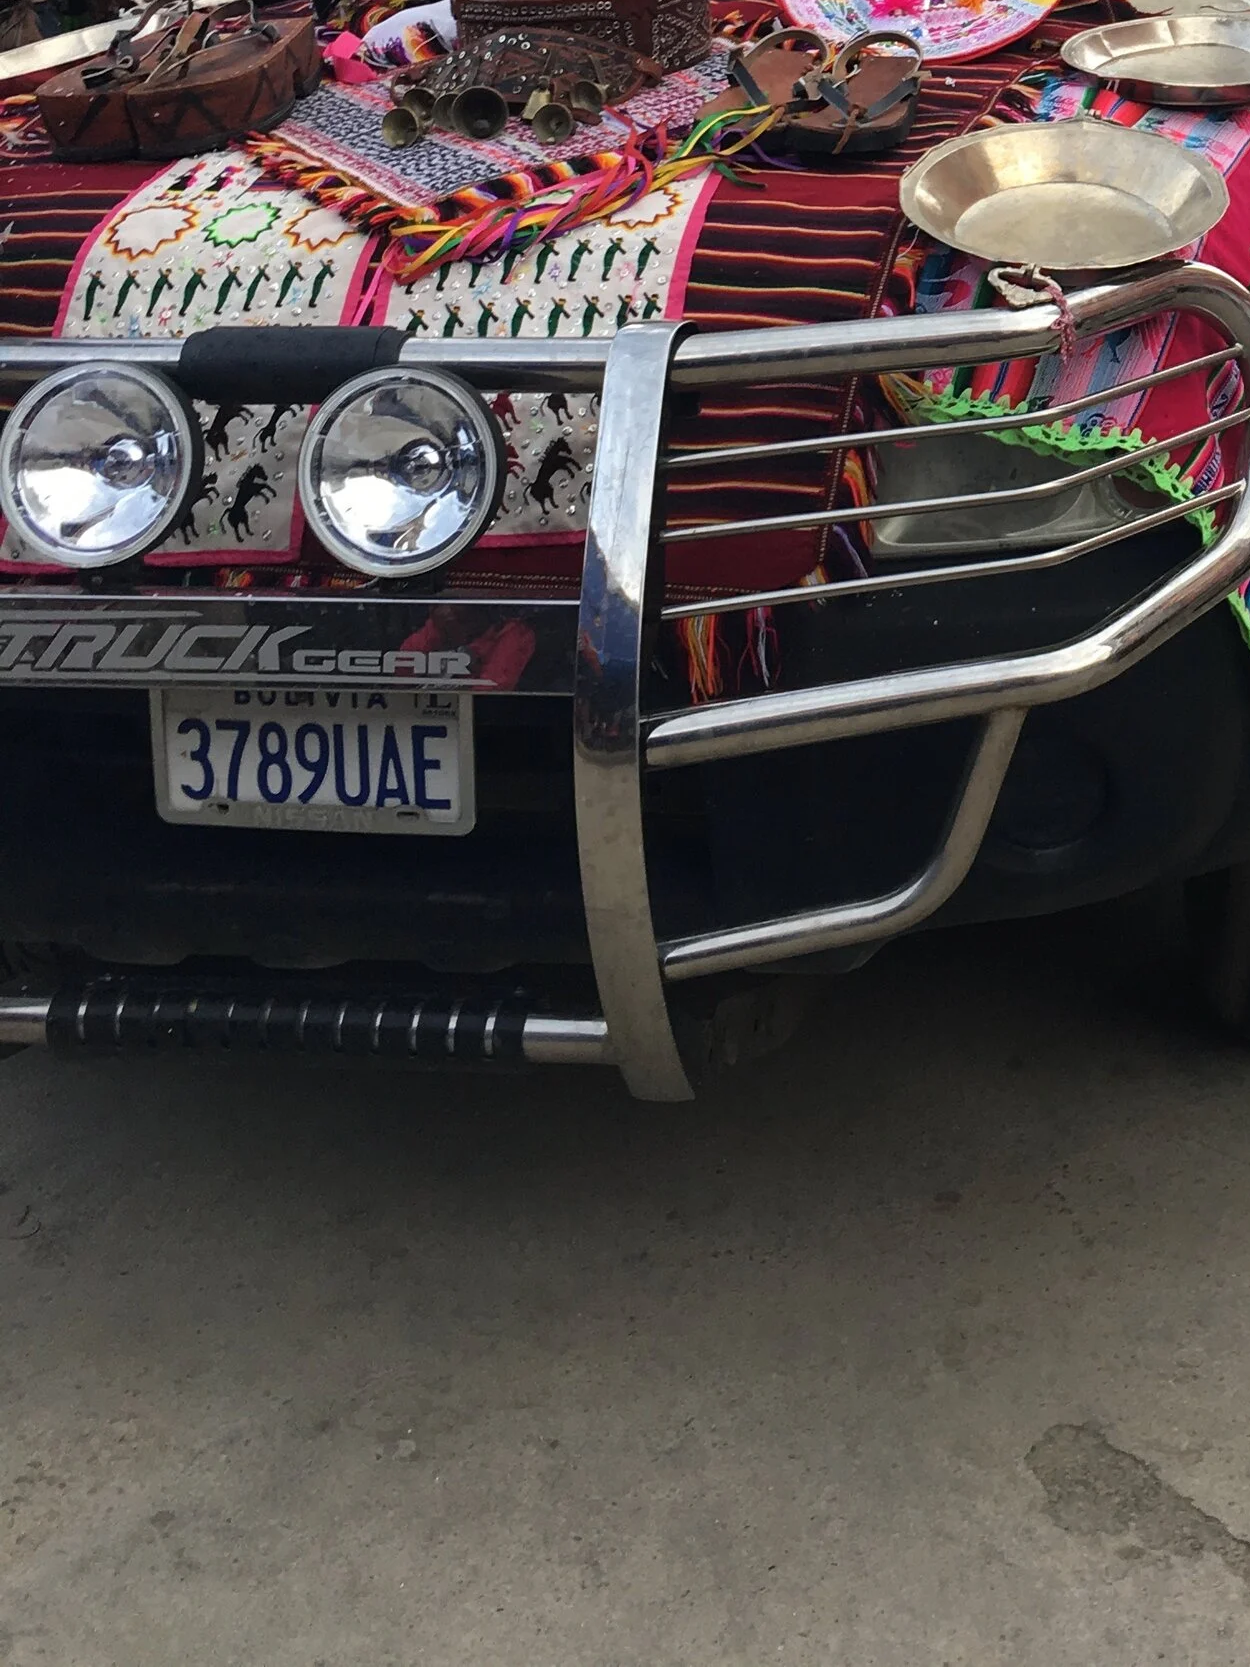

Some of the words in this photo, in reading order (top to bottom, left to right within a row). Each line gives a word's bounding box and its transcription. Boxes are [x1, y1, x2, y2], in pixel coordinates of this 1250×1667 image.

[0, 623, 312, 671] TRUCK
[293, 650, 471, 674] GEAR
[177, 718, 452, 811] 3789UAE
[254, 805, 375, 832] NISSAN
